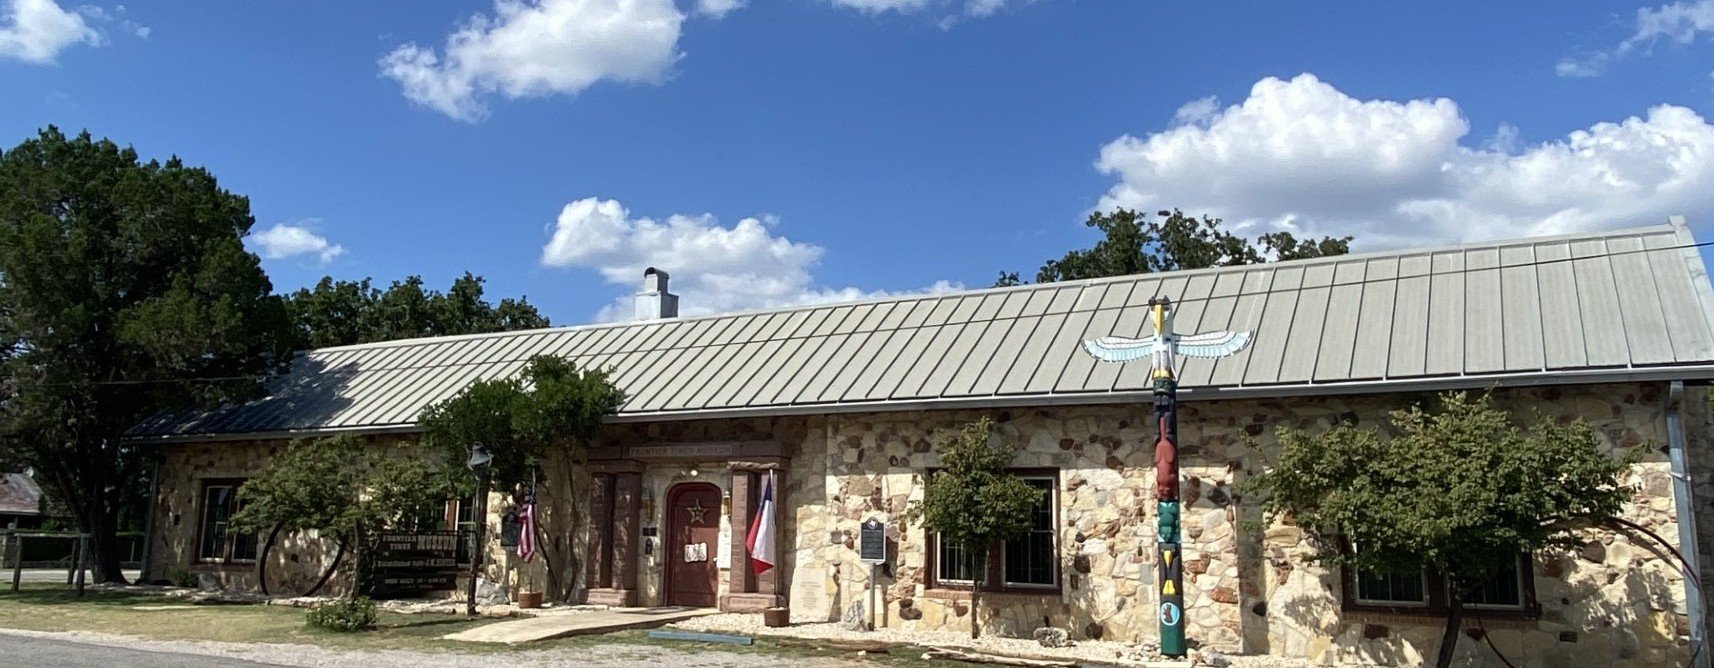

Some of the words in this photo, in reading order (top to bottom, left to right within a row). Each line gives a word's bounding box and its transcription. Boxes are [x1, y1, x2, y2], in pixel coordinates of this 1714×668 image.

[631, 447, 668, 456] FRONTIER
[671, 446, 695, 455] TIMES
[697, 445, 730, 454] MUSEUM
[417, 534, 458, 550] MUSEUM
